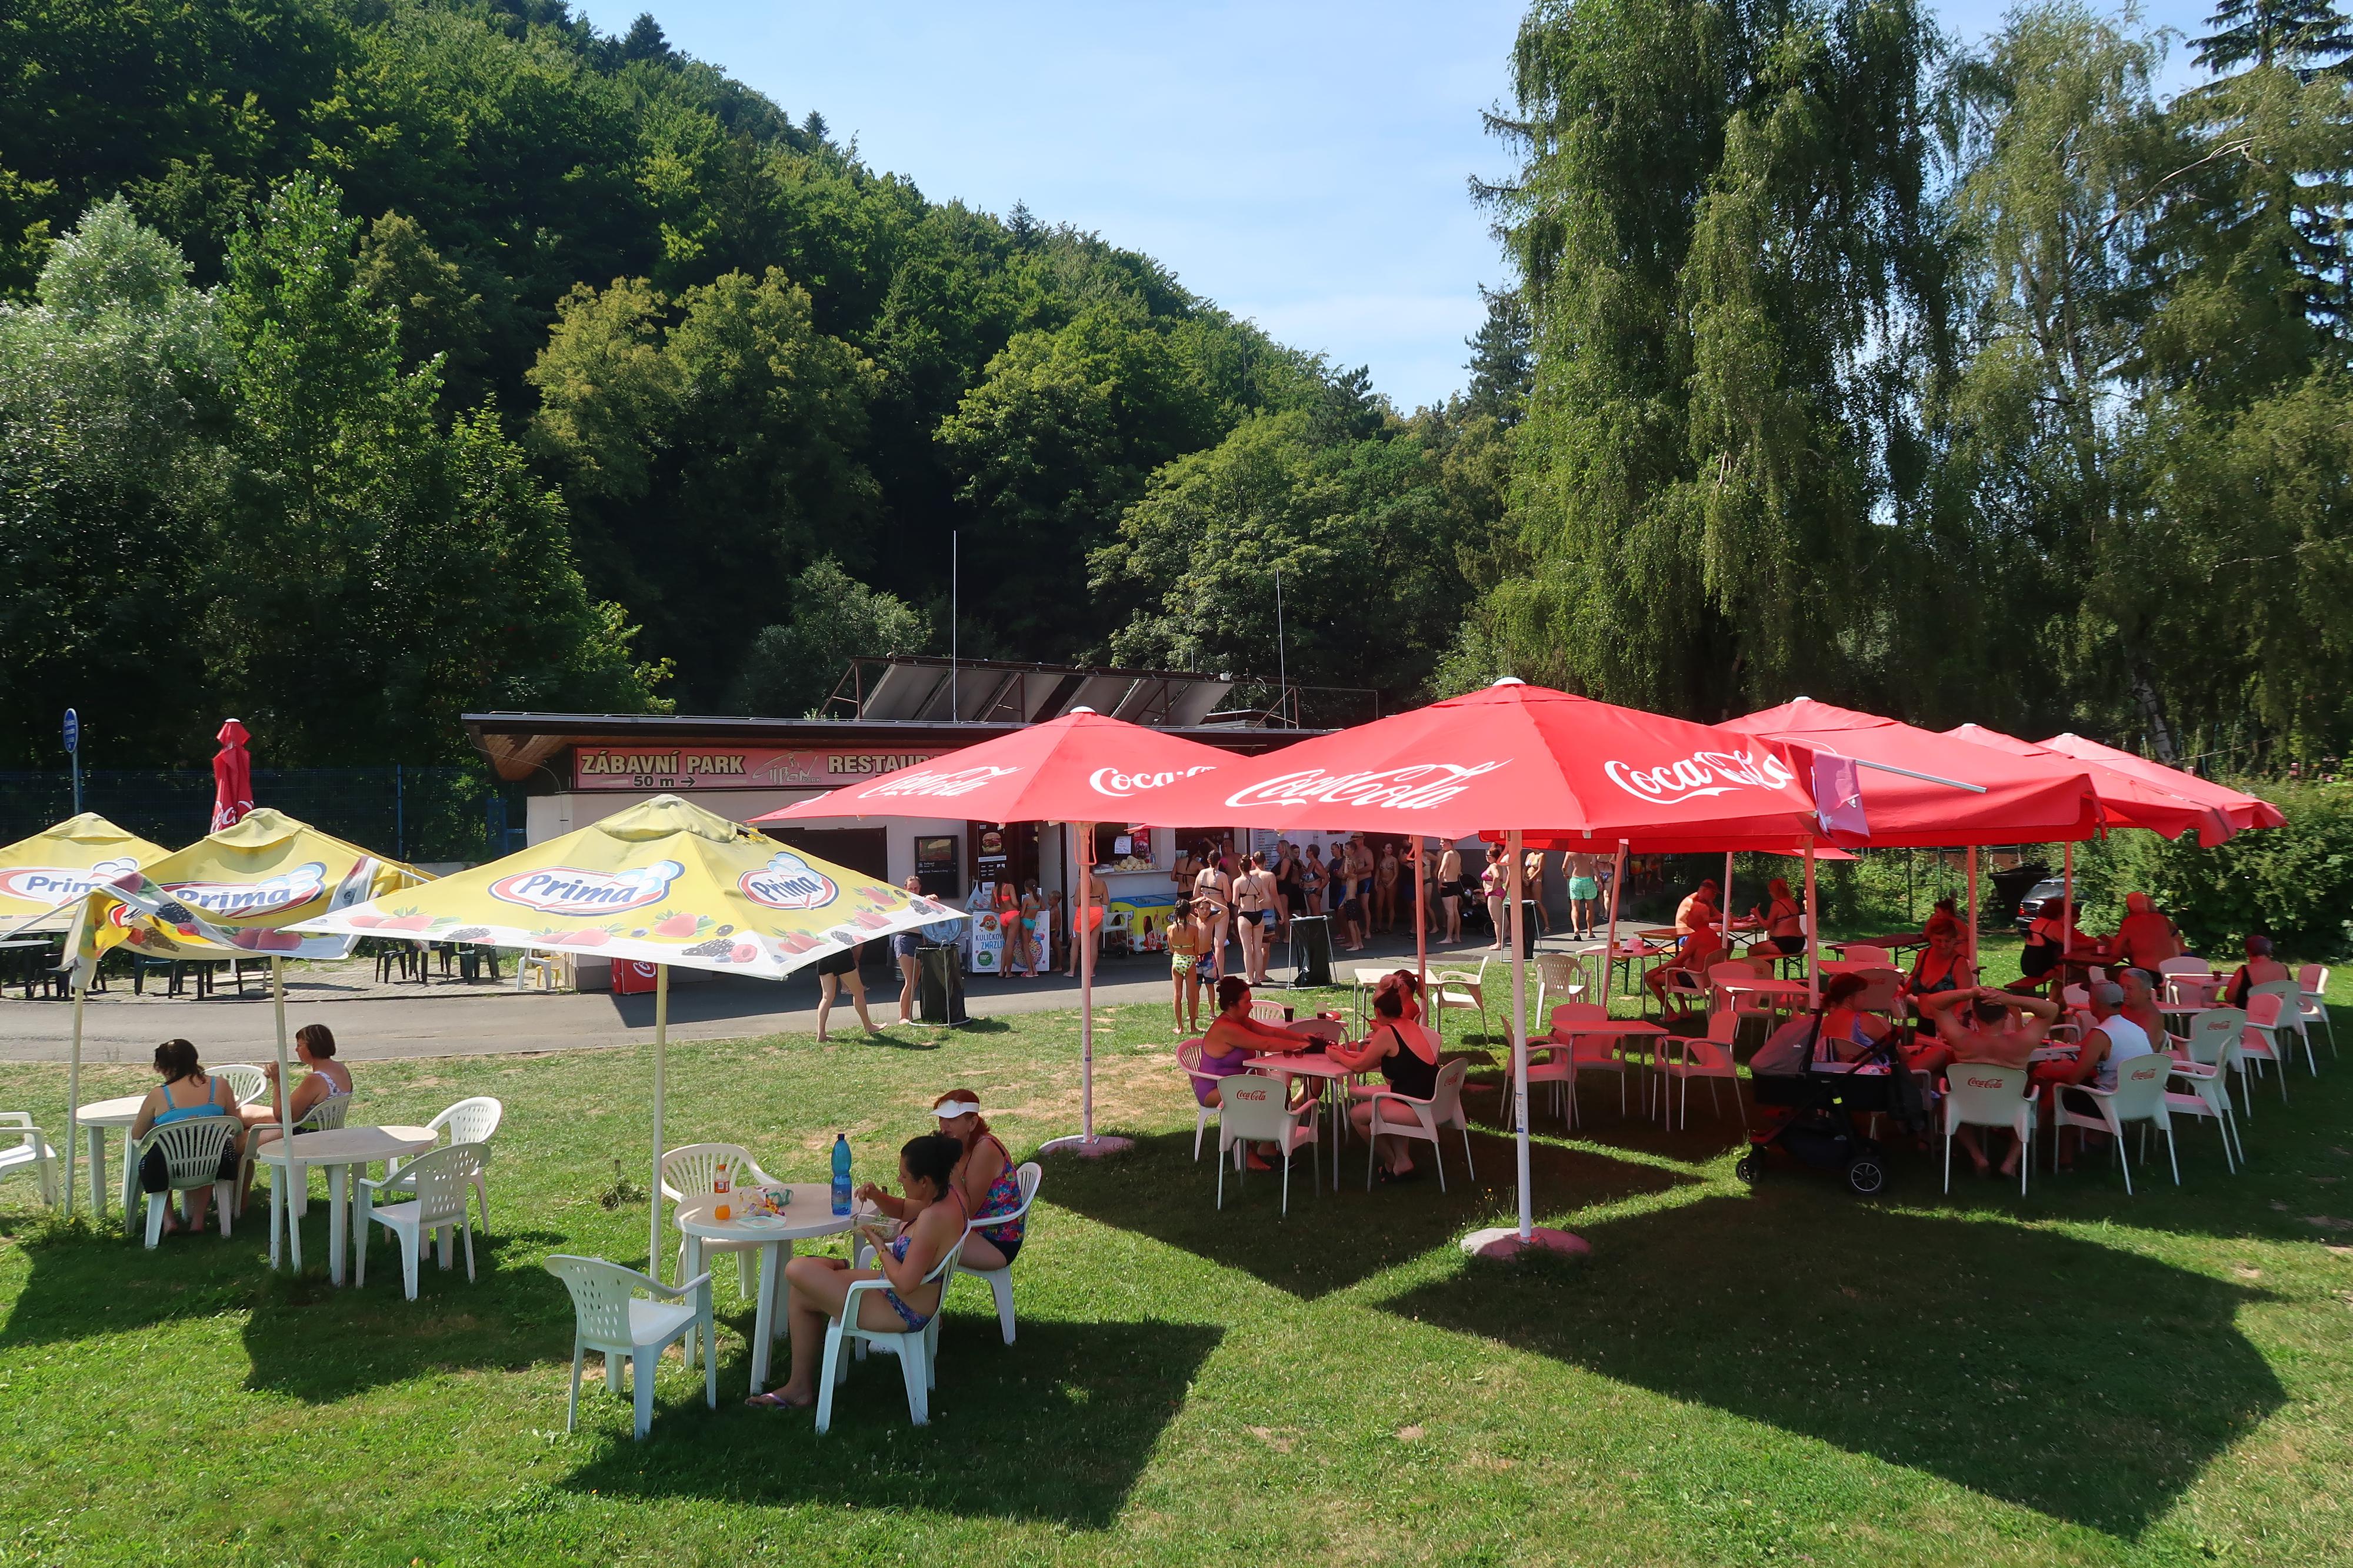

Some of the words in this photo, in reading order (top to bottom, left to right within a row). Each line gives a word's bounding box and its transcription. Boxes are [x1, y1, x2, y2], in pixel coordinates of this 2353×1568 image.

[581, 750, 681, 774] ZÁBAVNÍ
[686, 755, 746, 774] PARK
[828, 755, 943, 773] RESTAU
[633, 775, 654, 787] 50
[659, 778, 675, 787] m
[1089, 766, 1218, 797] Coca-
[1225, 758, 1515, 809] Coca-Cola
[26, 876, 102, 893] Prim
[517, 875, 640, 903] Prima
[751, 875, 825, 902] Prima
[176, 888, 291, 908] Prima
